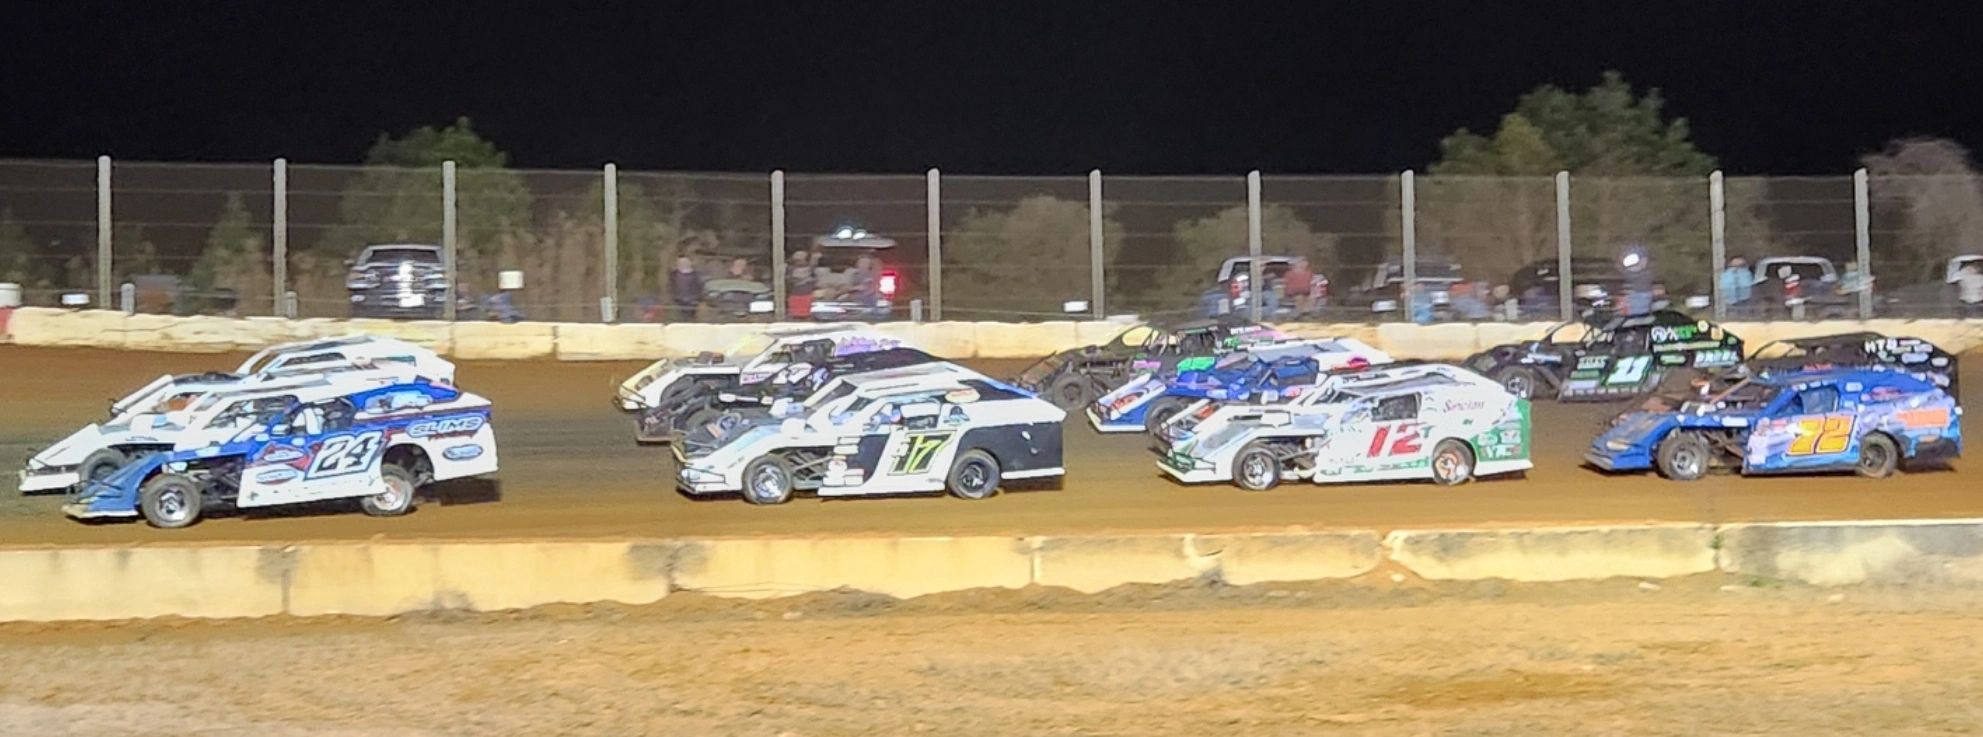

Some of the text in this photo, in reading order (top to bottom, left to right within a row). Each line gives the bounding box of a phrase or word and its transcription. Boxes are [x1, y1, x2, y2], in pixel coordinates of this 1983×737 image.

[1606, 355, 1652, 384] 11
[409, 416, 484, 436] SLIMS
[1366, 423, 1423, 458] 12
[303, 430, 382, 480] 24
[886, 429, 957, 476] 17
